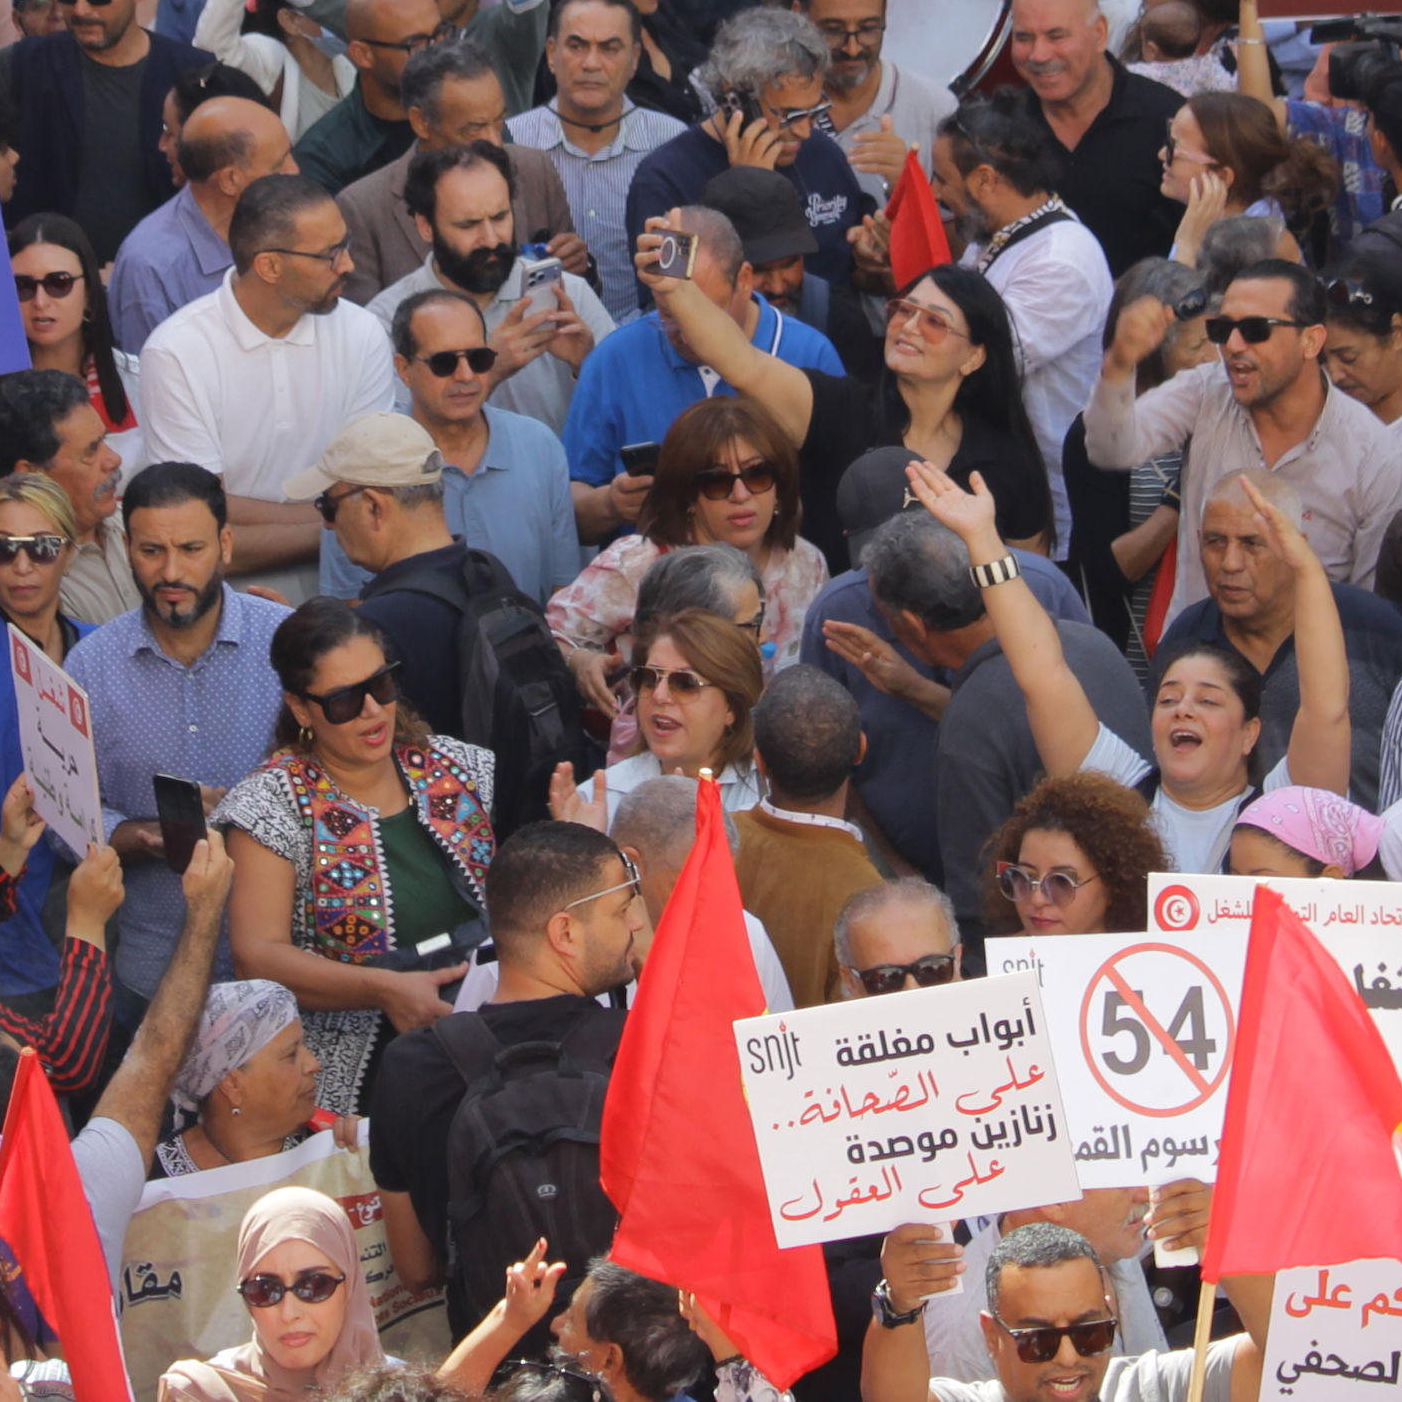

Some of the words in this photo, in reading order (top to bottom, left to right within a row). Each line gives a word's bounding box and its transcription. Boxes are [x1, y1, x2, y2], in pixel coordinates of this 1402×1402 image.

[1324, 904, 1365, 928] العام
[836, 1029, 935, 1067] مغلقة
[947, 997, 1037, 1057] أبواب
[1100, 984, 1216, 1076] 54
[955, 1055, 1046, 1116] على
[846, 1126, 958, 1164] موصدة
[970, 1104, 1058, 1150] زنازين
[780, 1163, 903, 1223] العقول
[918, 1150, 1006, 1210] على
[1285, 1269, 1353, 1318] على
